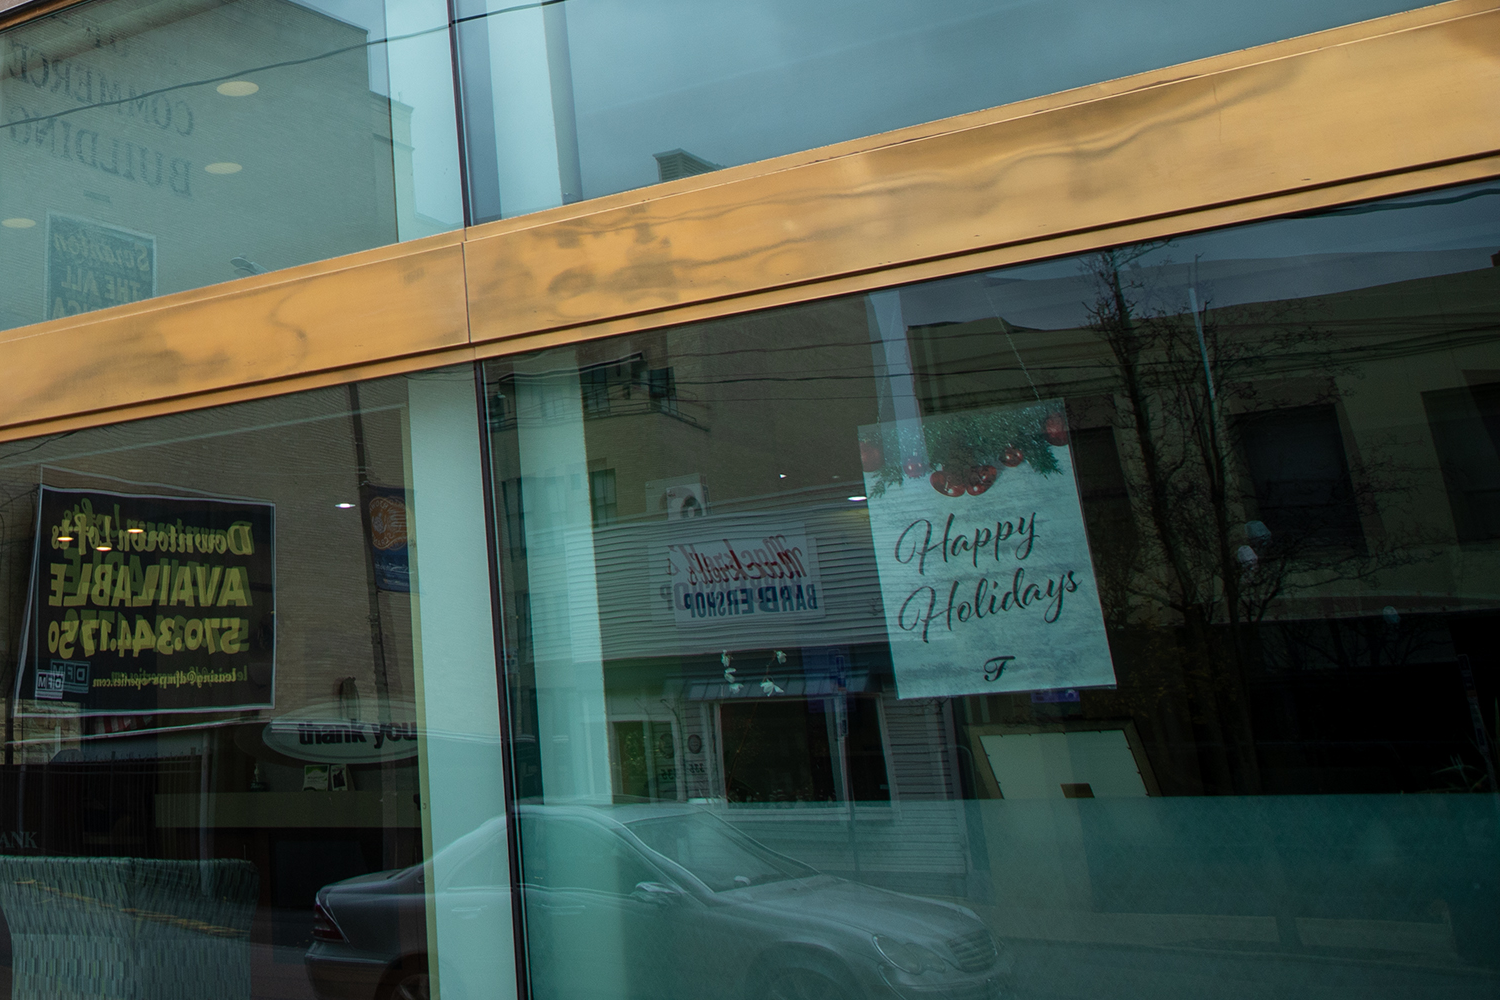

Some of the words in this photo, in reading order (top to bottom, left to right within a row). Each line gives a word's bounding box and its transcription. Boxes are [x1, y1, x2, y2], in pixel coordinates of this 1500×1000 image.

[894, 511, 1041, 575] Happy
[897, 567, 1082, 644] Holidays
[297, 719, 367, 745] thank
